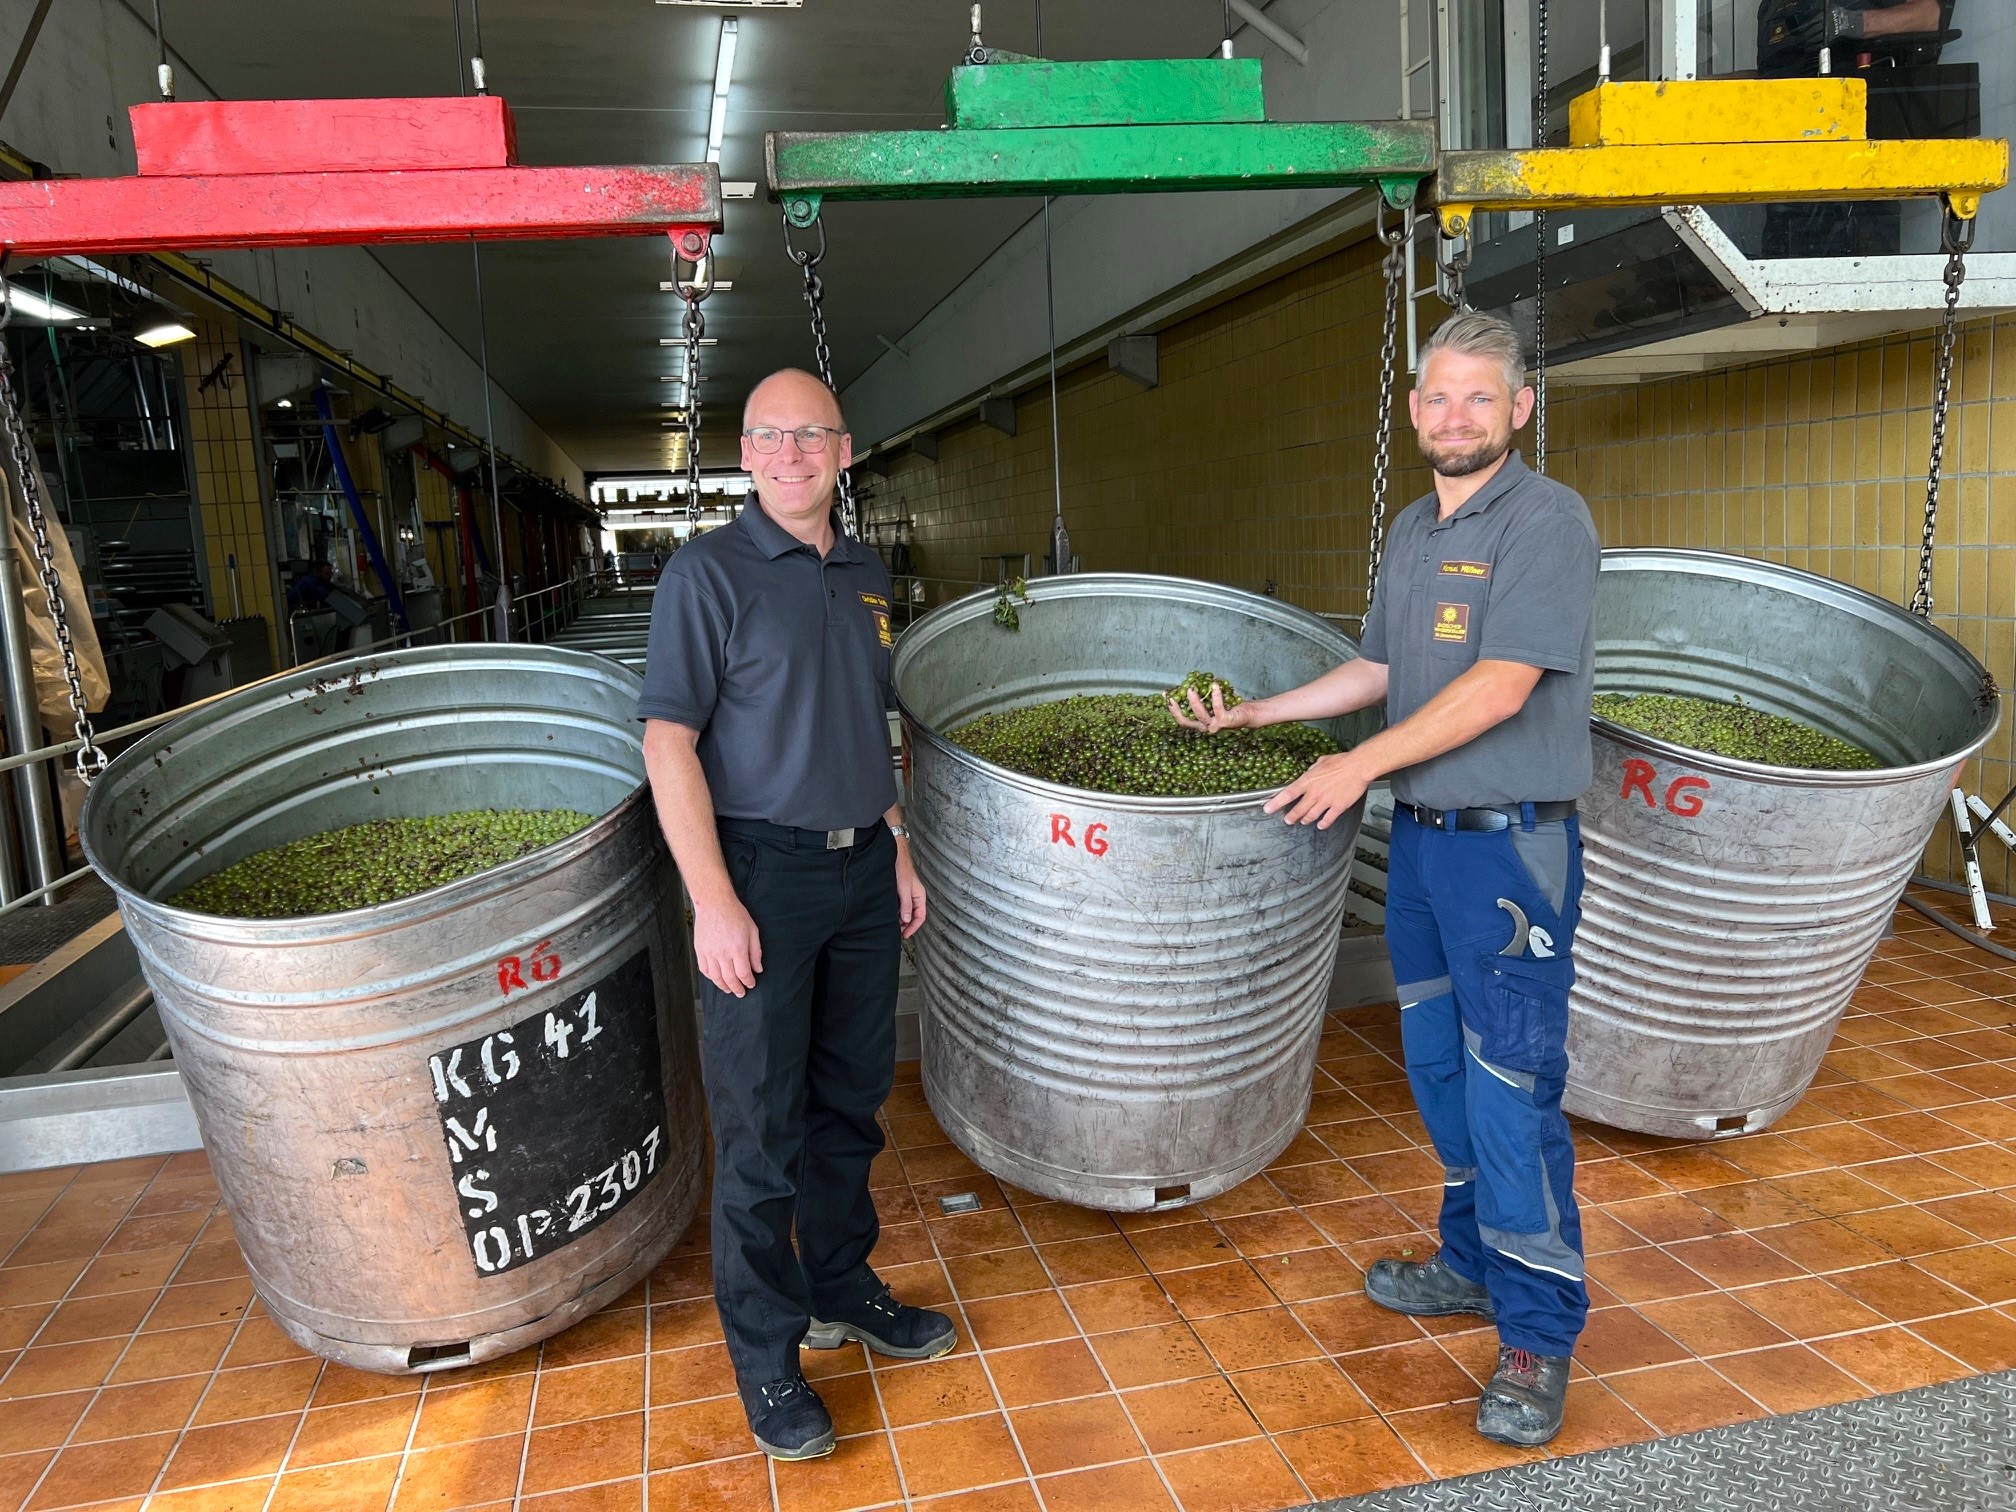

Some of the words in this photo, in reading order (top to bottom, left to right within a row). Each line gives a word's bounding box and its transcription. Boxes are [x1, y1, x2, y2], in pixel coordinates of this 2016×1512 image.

[1619, 756, 1711, 818] RG
[1049, 813, 1109, 858] RG
[428, 1031, 521, 1104] KG
[544, 989, 604, 1060] 41
[444, 1106, 499, 1164] M
[457, 1169, 499, 1219] S
